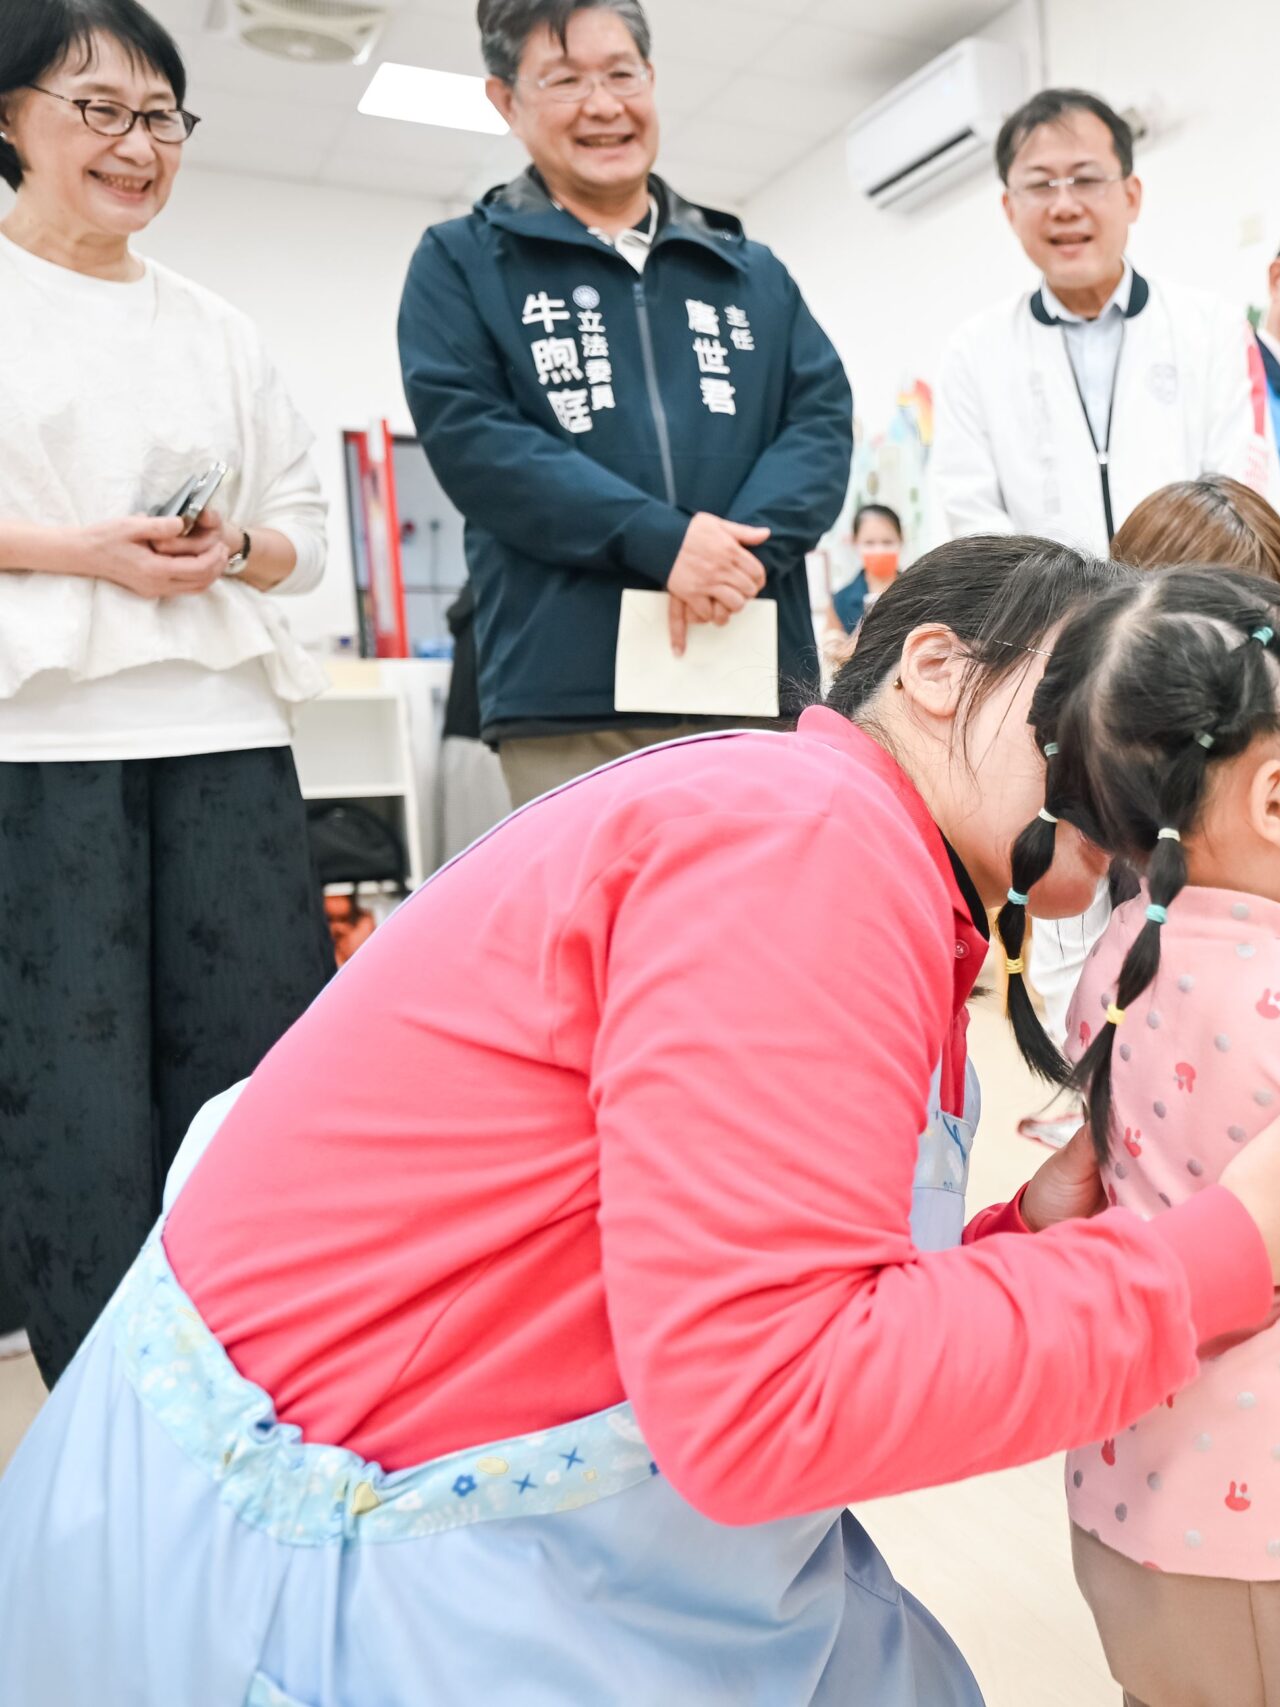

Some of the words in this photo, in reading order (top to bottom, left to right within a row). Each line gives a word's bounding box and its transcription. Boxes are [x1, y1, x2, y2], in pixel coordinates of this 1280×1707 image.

[522, 291, 594, 434] 牛煦庭
[577, 310, 616, 412] 立法委員
